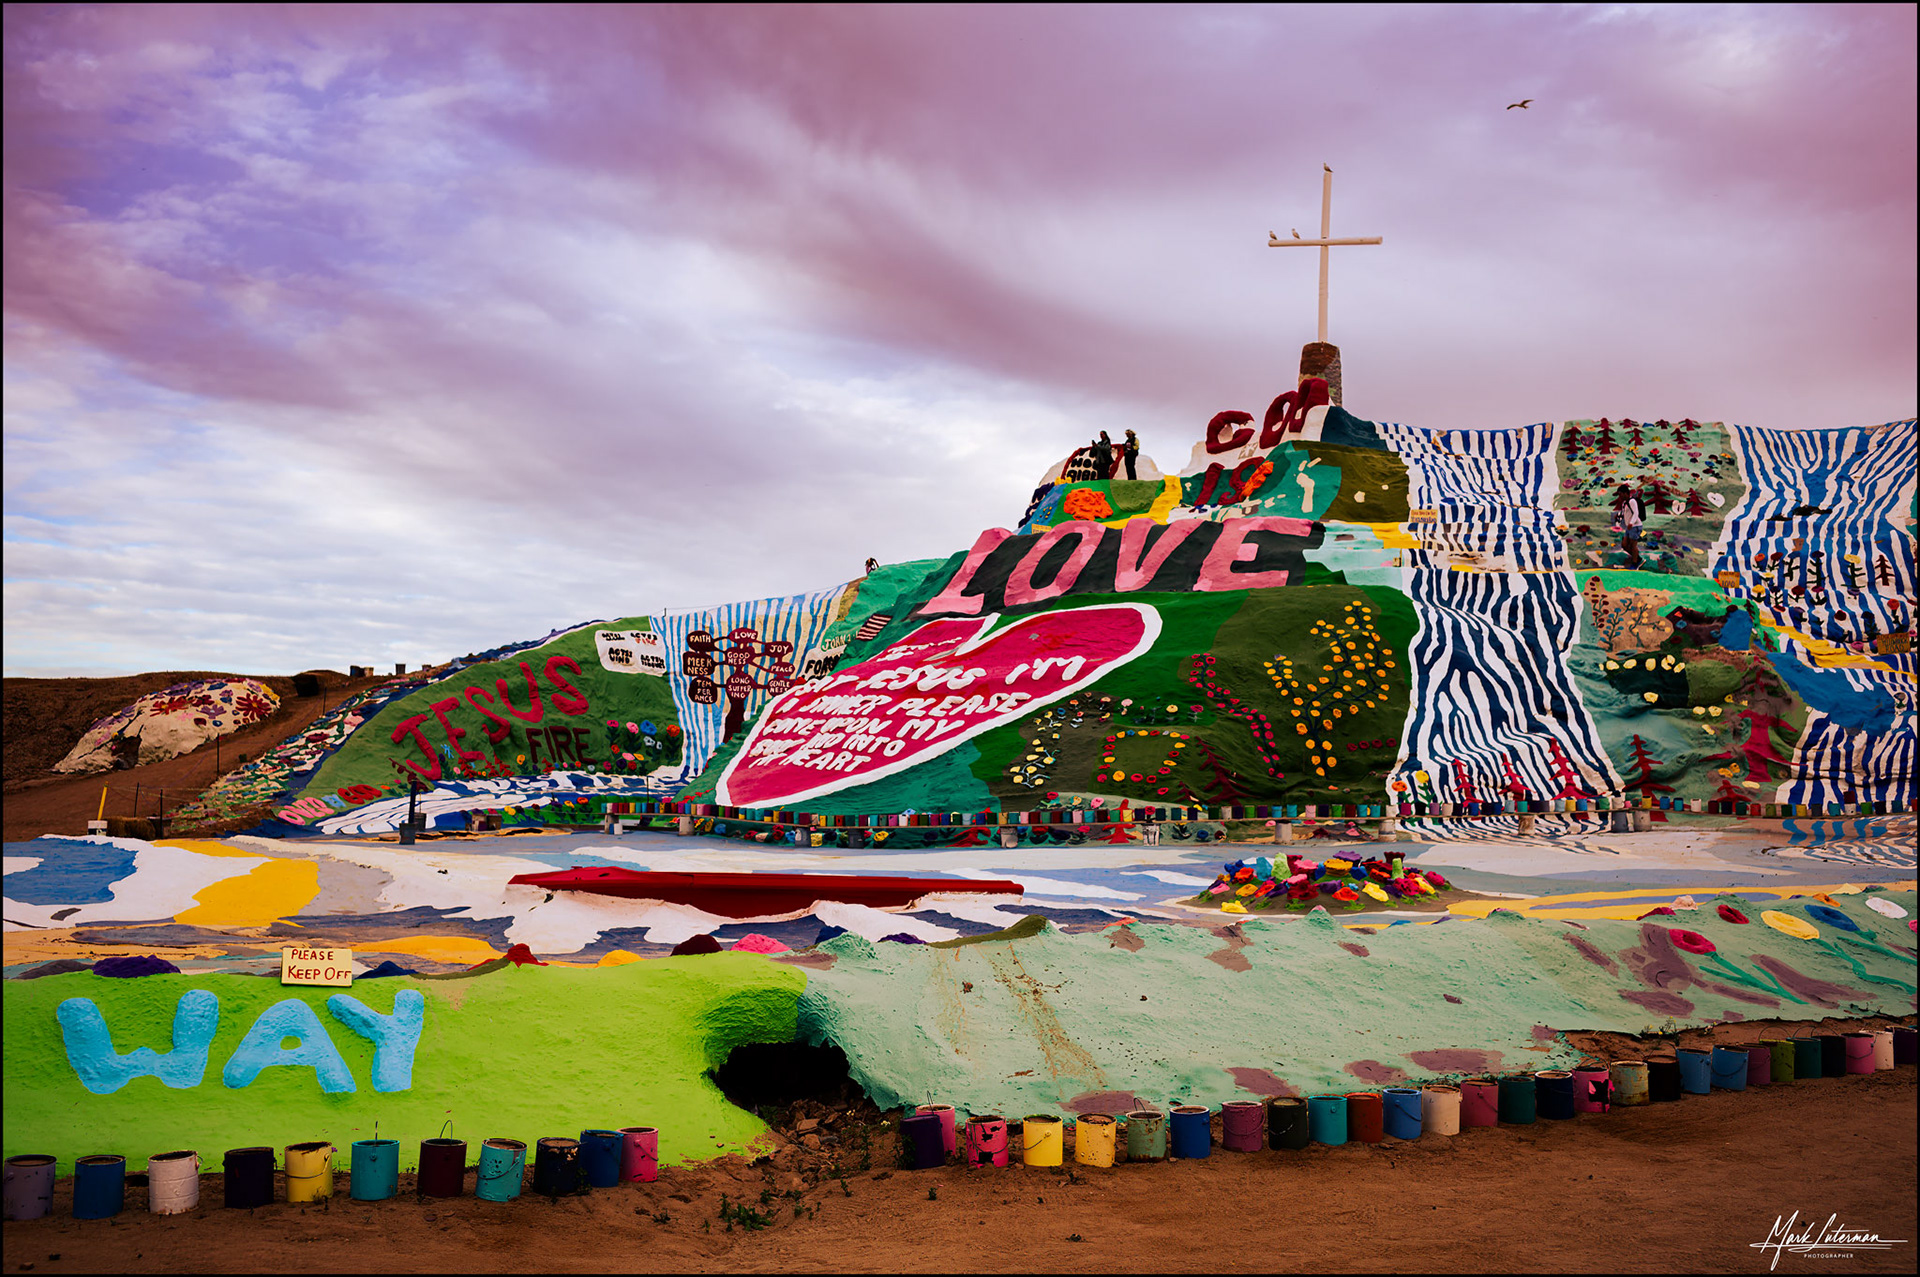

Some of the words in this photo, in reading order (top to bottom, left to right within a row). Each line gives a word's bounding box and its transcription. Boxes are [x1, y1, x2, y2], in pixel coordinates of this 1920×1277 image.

[917, 516, 1315, 616] LOVE
[689, 634, 712, 643] FAITH
[734, 631, 757, 640] LOVE
[769, 644, 789, 655] JOY
[727, 651, 750, 659] GOOD
[687, 656, 712, 668] MEEK
[687, 666, 709, 676] NESS
[771, 665, 793, 673] PEACE
[697, 679, 712, 688] TEM
[730, 677, 750, 685] LONG
[769, 680, 791, 688] GENTLE
[696, 688, 712, 696] PER
[728, 685, 751, 693] SUFFER
[694, 694, 714, 703] ANCE
[886, 692, 1032, 717] PLEASE
[391, 655, 590, 781] JESUS
[896, 718, 965, 741] MY
[525, 725, 598, 764] FIRE
[841, 734, 906, 757] INTO
[778, 746, 872, 772] HEART
[291, 948, 334, 960] PLEASE
[57, 989, 425, 1095] WAY
